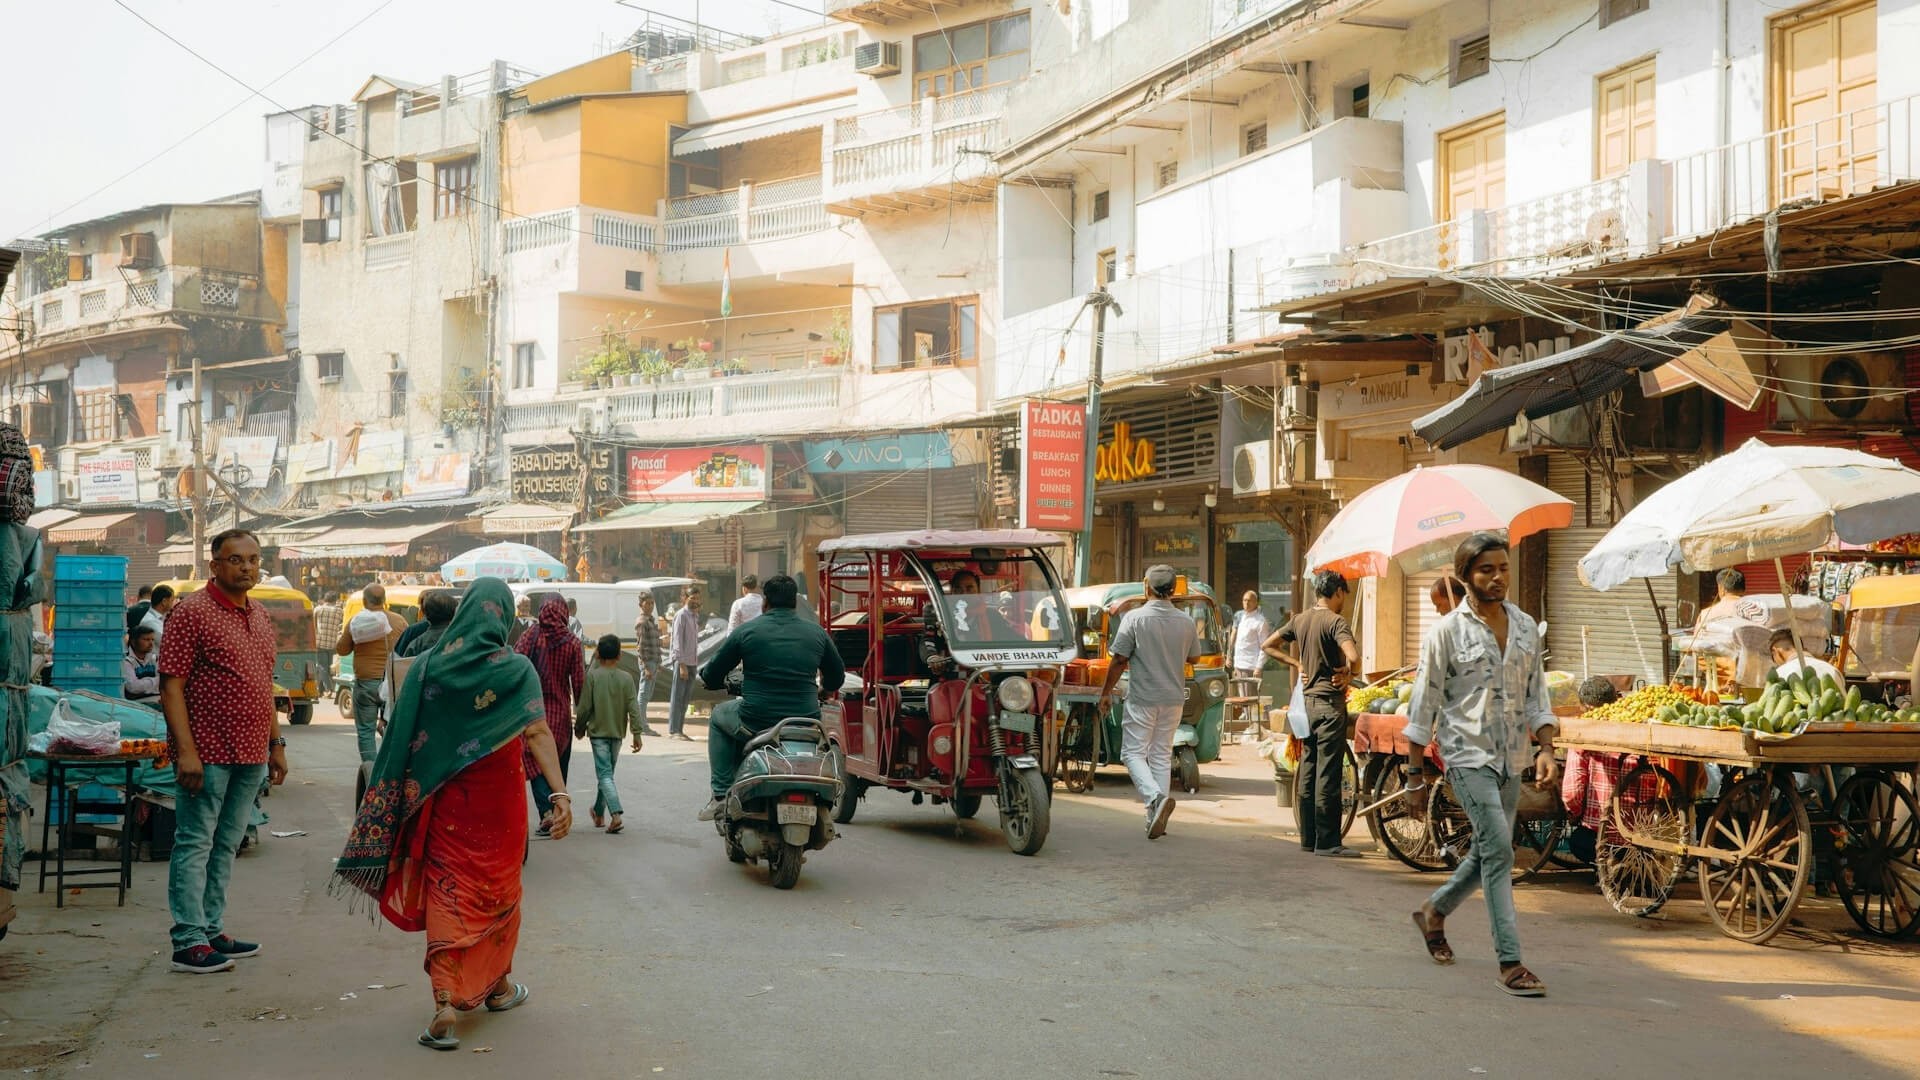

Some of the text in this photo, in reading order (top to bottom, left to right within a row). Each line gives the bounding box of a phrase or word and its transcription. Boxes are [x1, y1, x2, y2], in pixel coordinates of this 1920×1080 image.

[1360, 379, 1408, 406] RANGOLI
[1031, 407, 1083, 426] TADKA
[1032, 428, 1082, 441] RESTAURANT
[1032, 450, 1080, 464] BREAKFAST
[1096, 421, 1156, 482] adka
[93, 461, 111, 474] SPICE
[112, 459, 134, 472] MAKER
[511, 449, 610, 472] BABA DISPOLS
[631, 455, 666, 470] Pansari
[1040, 467, 1071, 479] LUNCH
[513, 480, 522, 494] &
[1040, 483, 1072, 494] DINNER
[971, 650, 1059, 662] VANDE BHARAT
